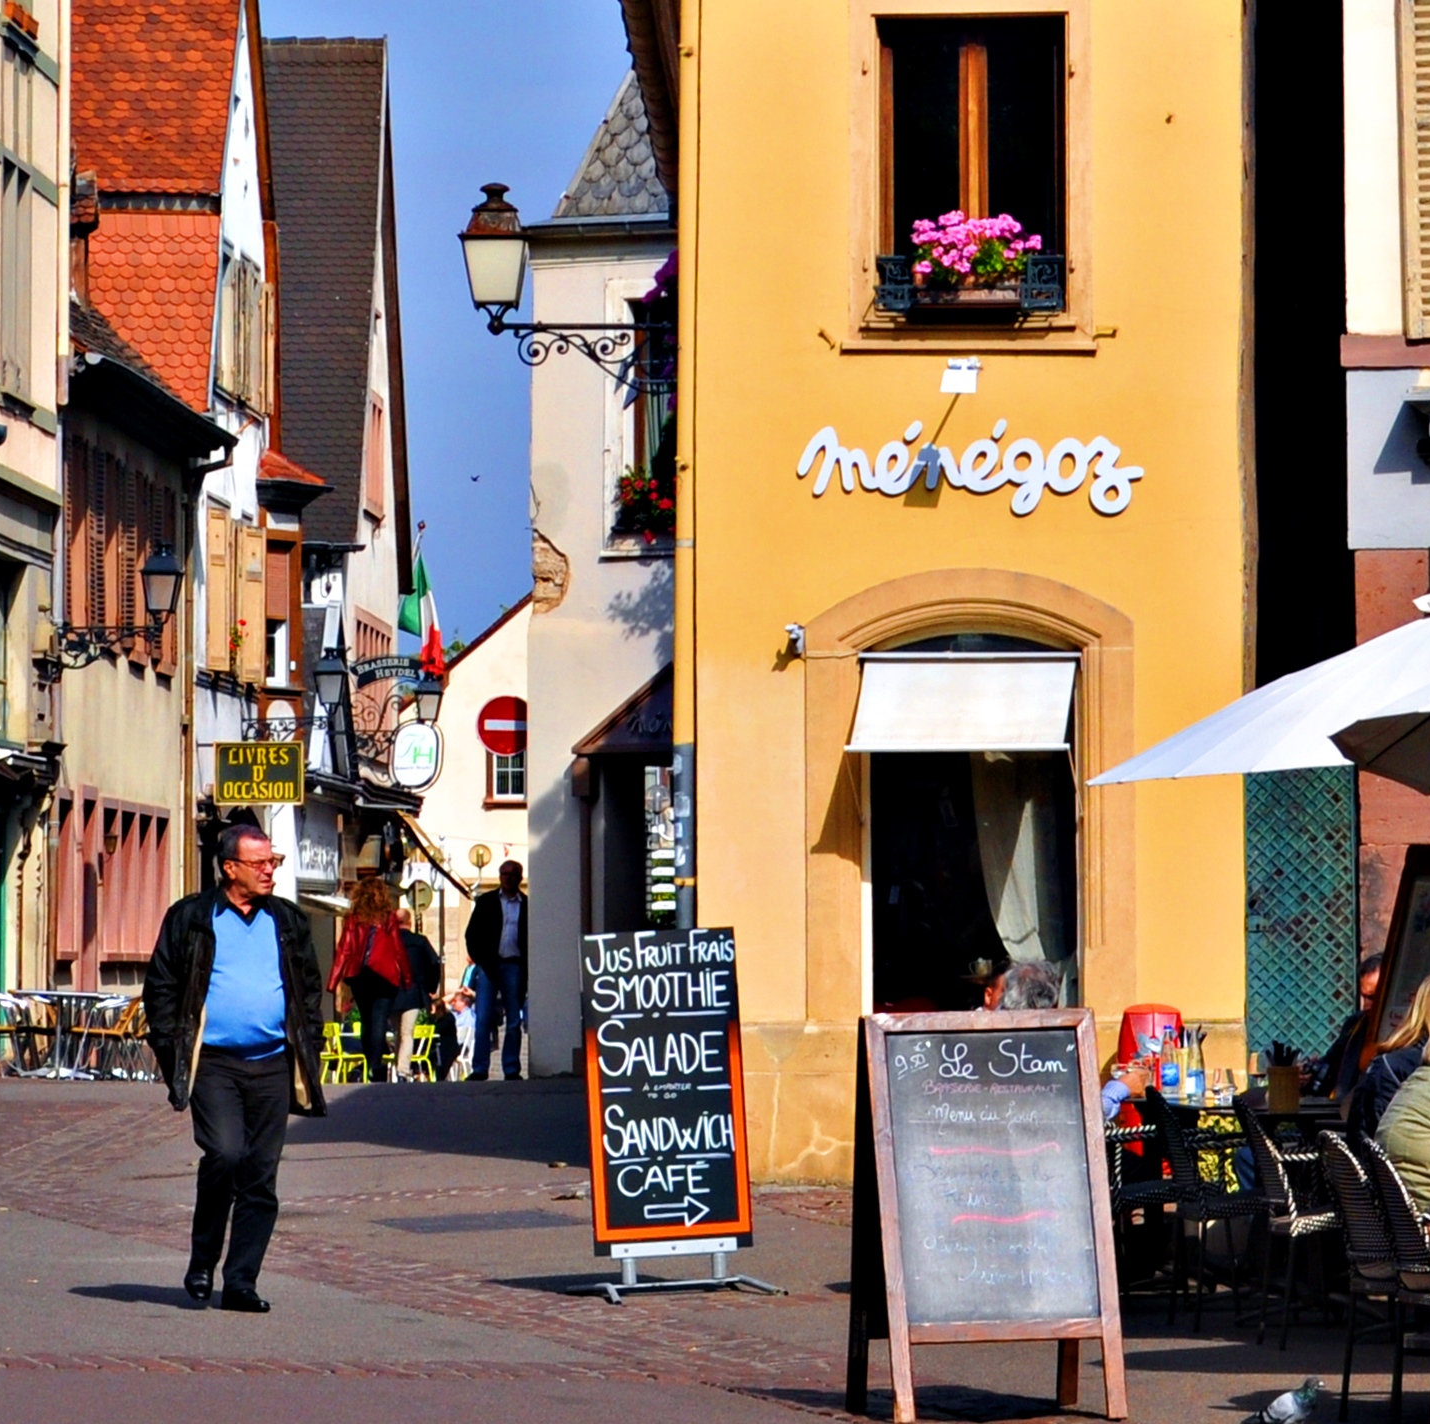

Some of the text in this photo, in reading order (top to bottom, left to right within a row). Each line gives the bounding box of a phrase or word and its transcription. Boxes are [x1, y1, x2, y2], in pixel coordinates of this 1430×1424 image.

[797, 418, 1144, 517] ménégoz
[356, 658, 410, 674] BRASSERIE
[374, 668, 417, 679] HEYDEL
[228, 747, 290, 765] LIVRES
[252, 765, 267, 782] D'
[223, 781, 294, 799] OCCASION
[591, 968, 731, 1013] SMOOTHIE
[597, 1019, 724, 1077] SALADE
[602, 1104, 736, 1158] SANDWICH
[617, 1161, 711, 1198] CAFÉ
